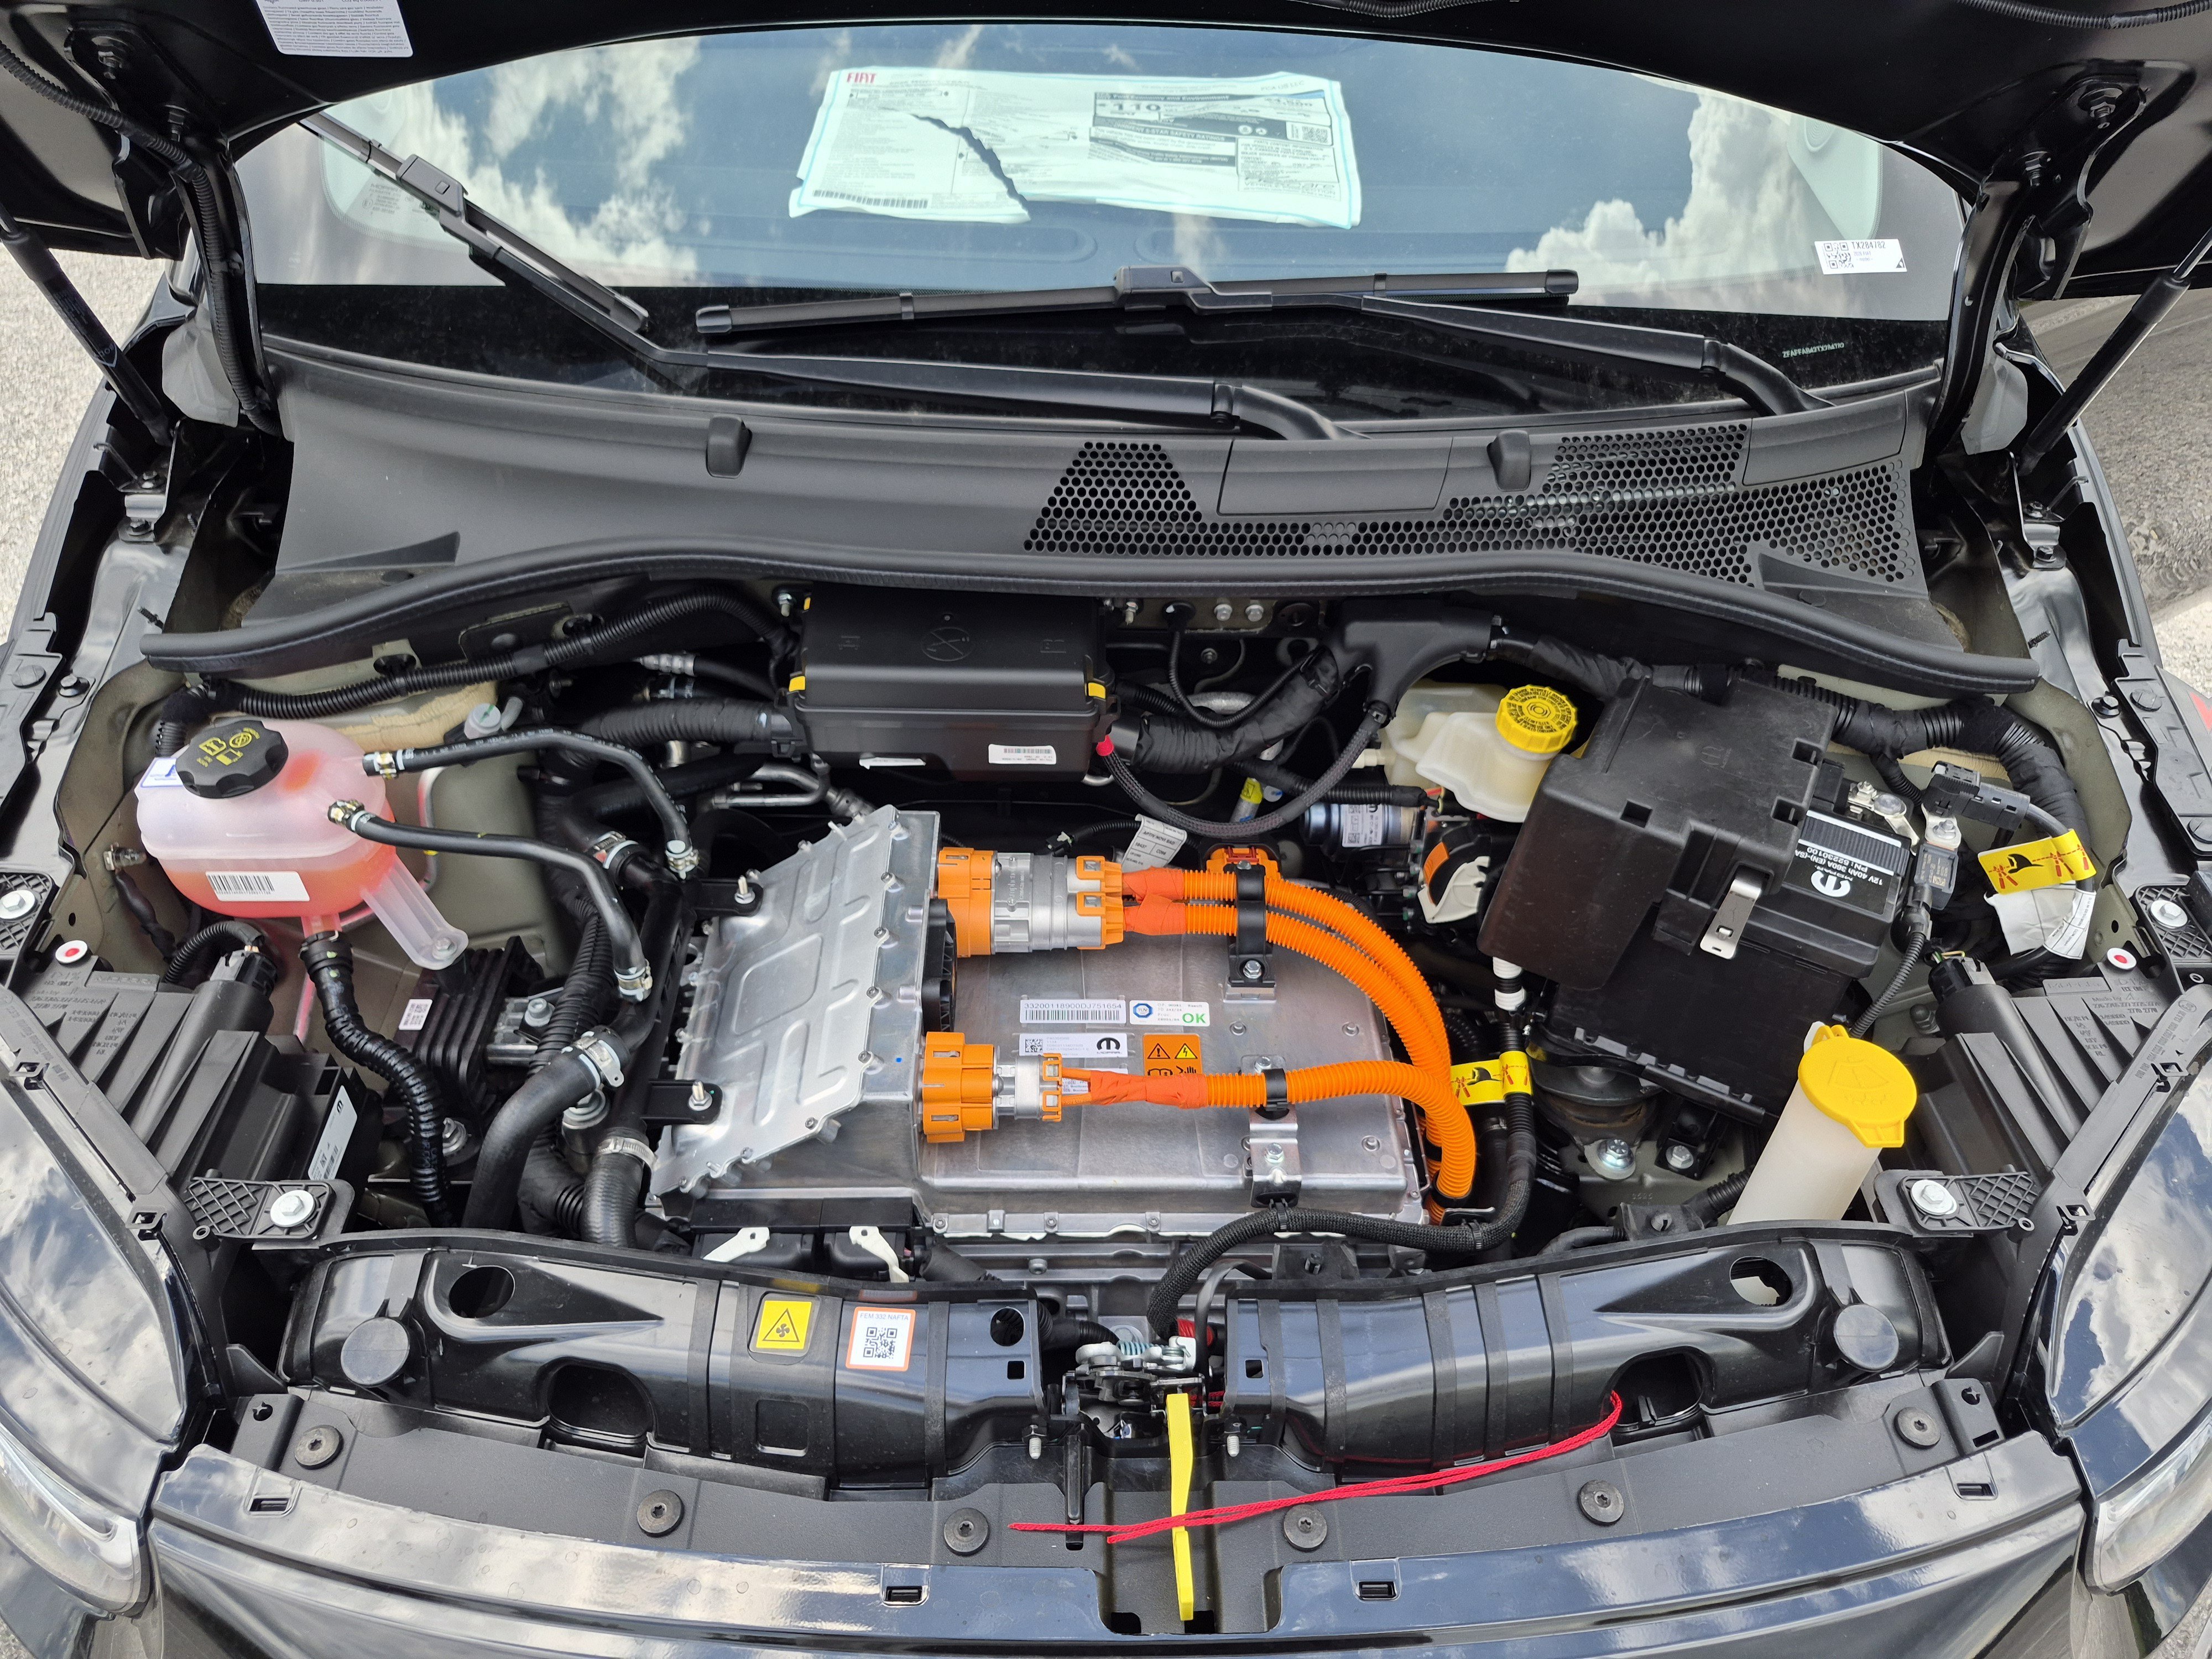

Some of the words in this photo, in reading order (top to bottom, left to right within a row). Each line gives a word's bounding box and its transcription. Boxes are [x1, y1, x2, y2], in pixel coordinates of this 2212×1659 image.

[847, 72, 877, 84] FIAT
[1851, 241, 1886, 249] TX284782
[1807, 847, 1849, 866] 52230100
[1848, 867, 1867, 879] 40Ah
[1868, 876, 1883, 886] 12V
[1182, 1013, 1206, 1023] OK
